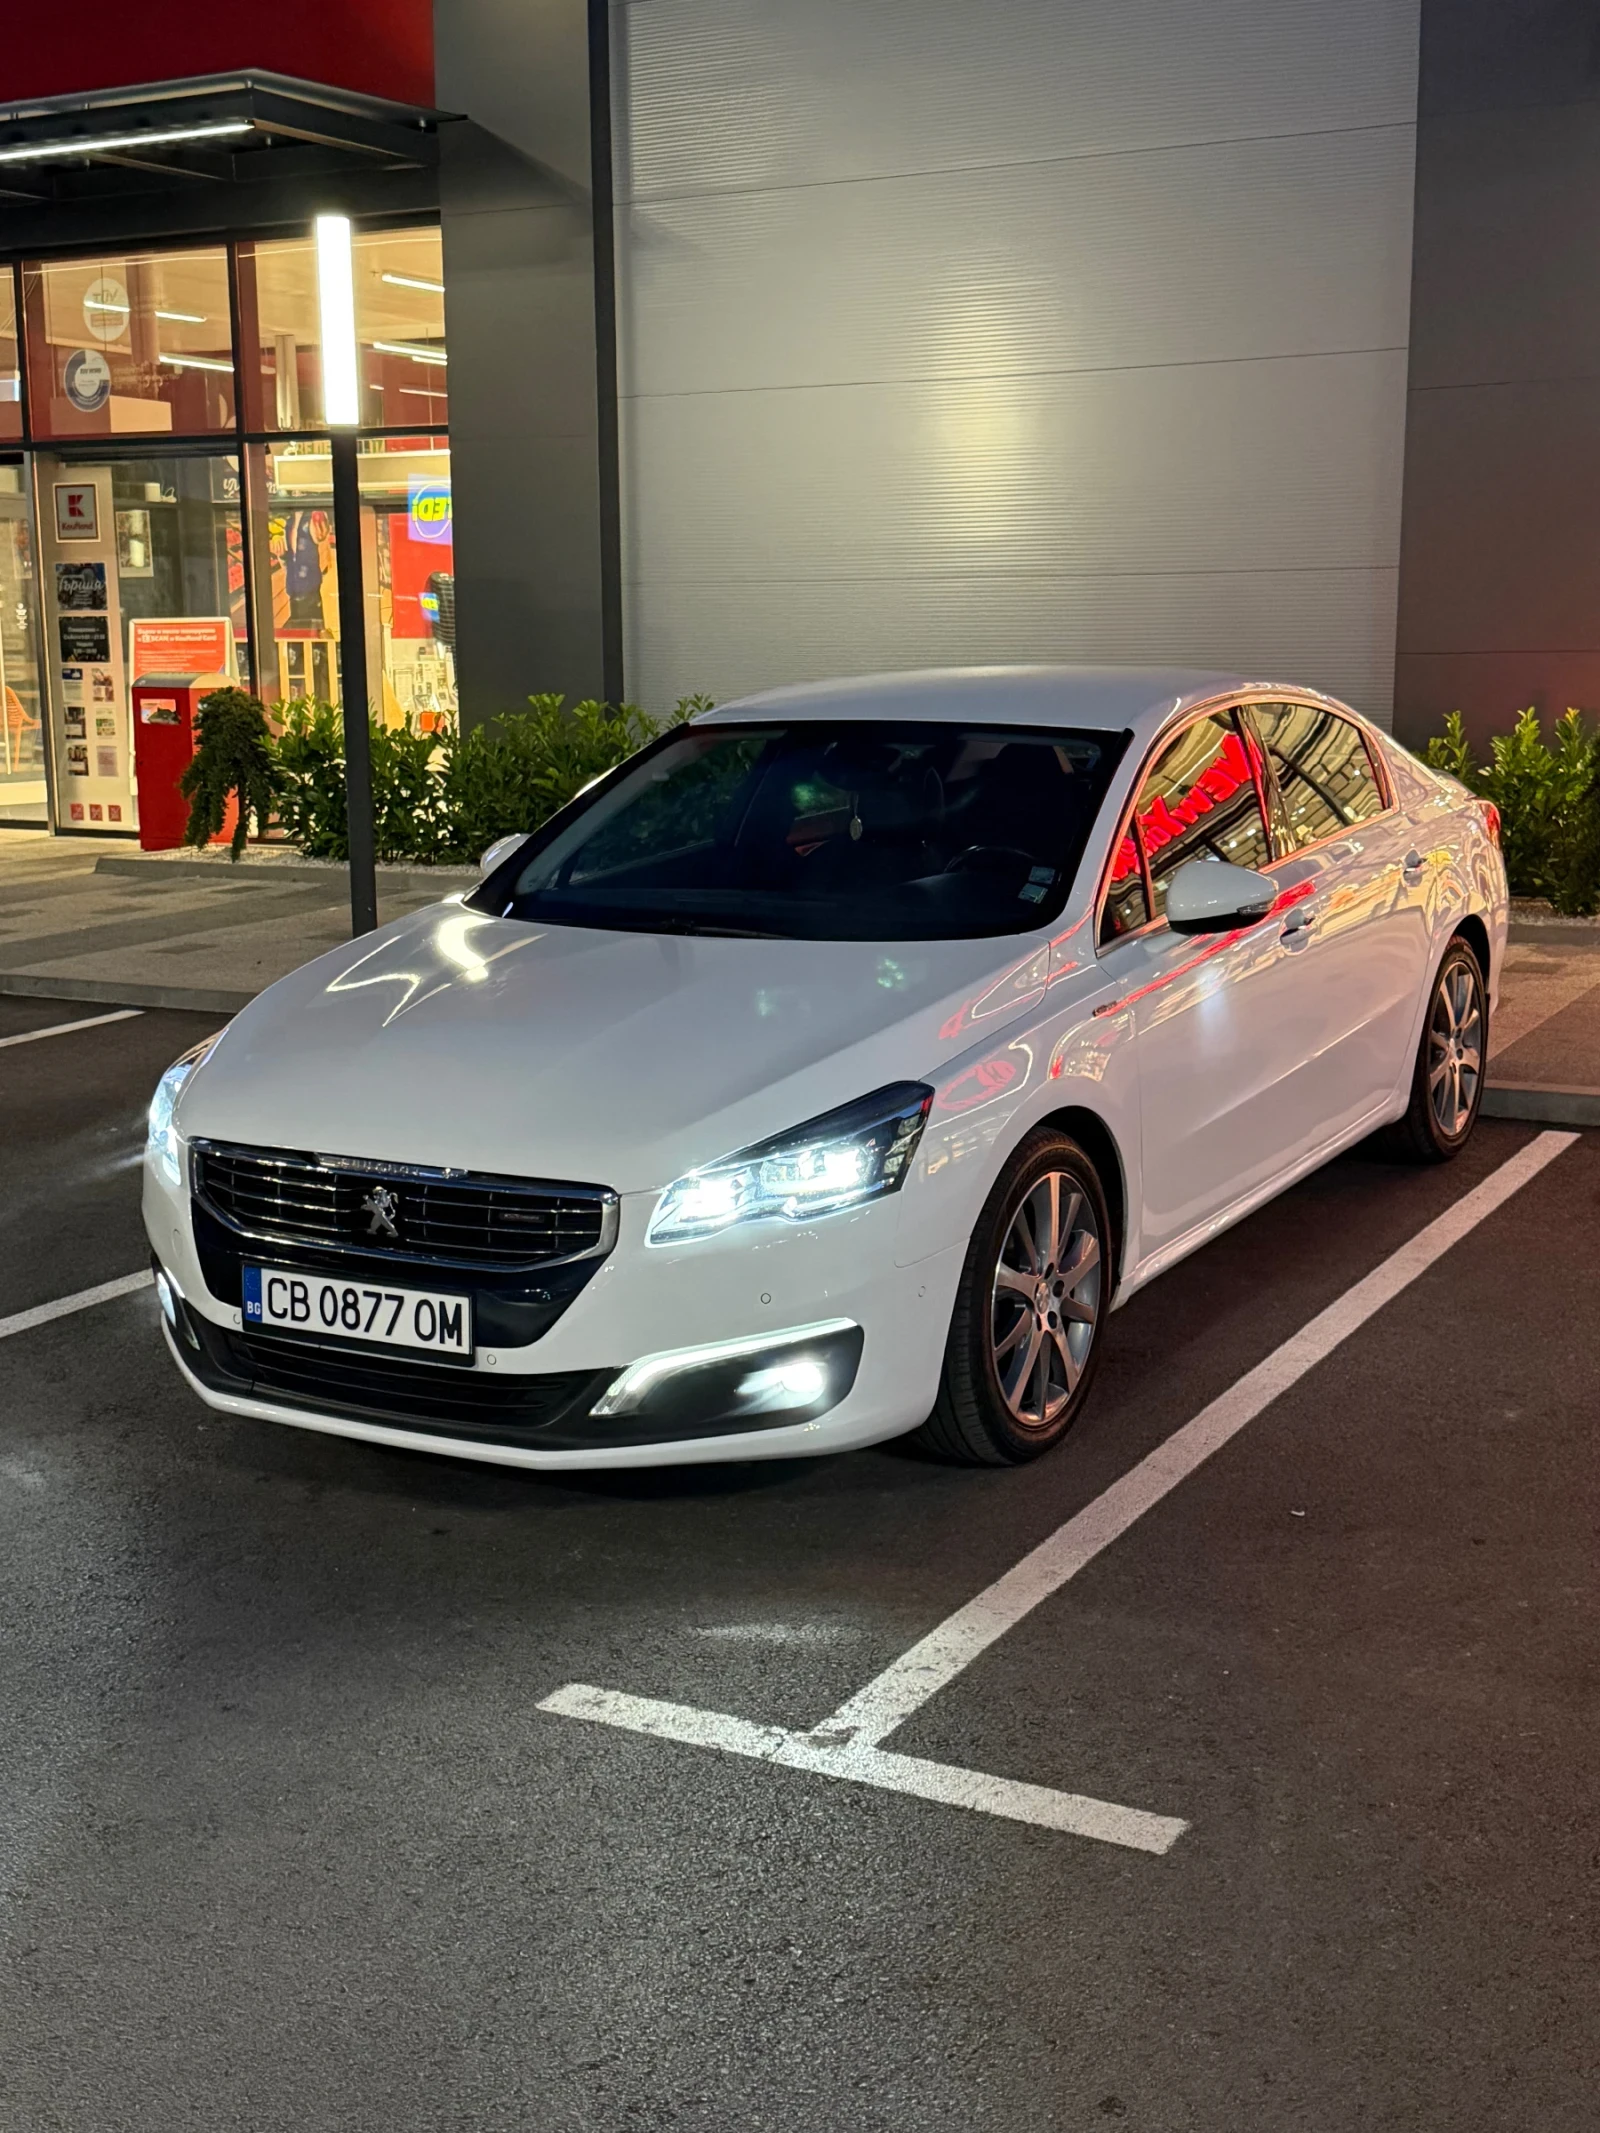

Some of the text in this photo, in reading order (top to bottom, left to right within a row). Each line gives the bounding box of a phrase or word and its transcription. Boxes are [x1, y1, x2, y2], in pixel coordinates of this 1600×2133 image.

[62, 521, 93, 531] Kaufland
[246, 1301, 261, 1316] BG
[268, 1277, 463, 1347] CB 0877 OM
